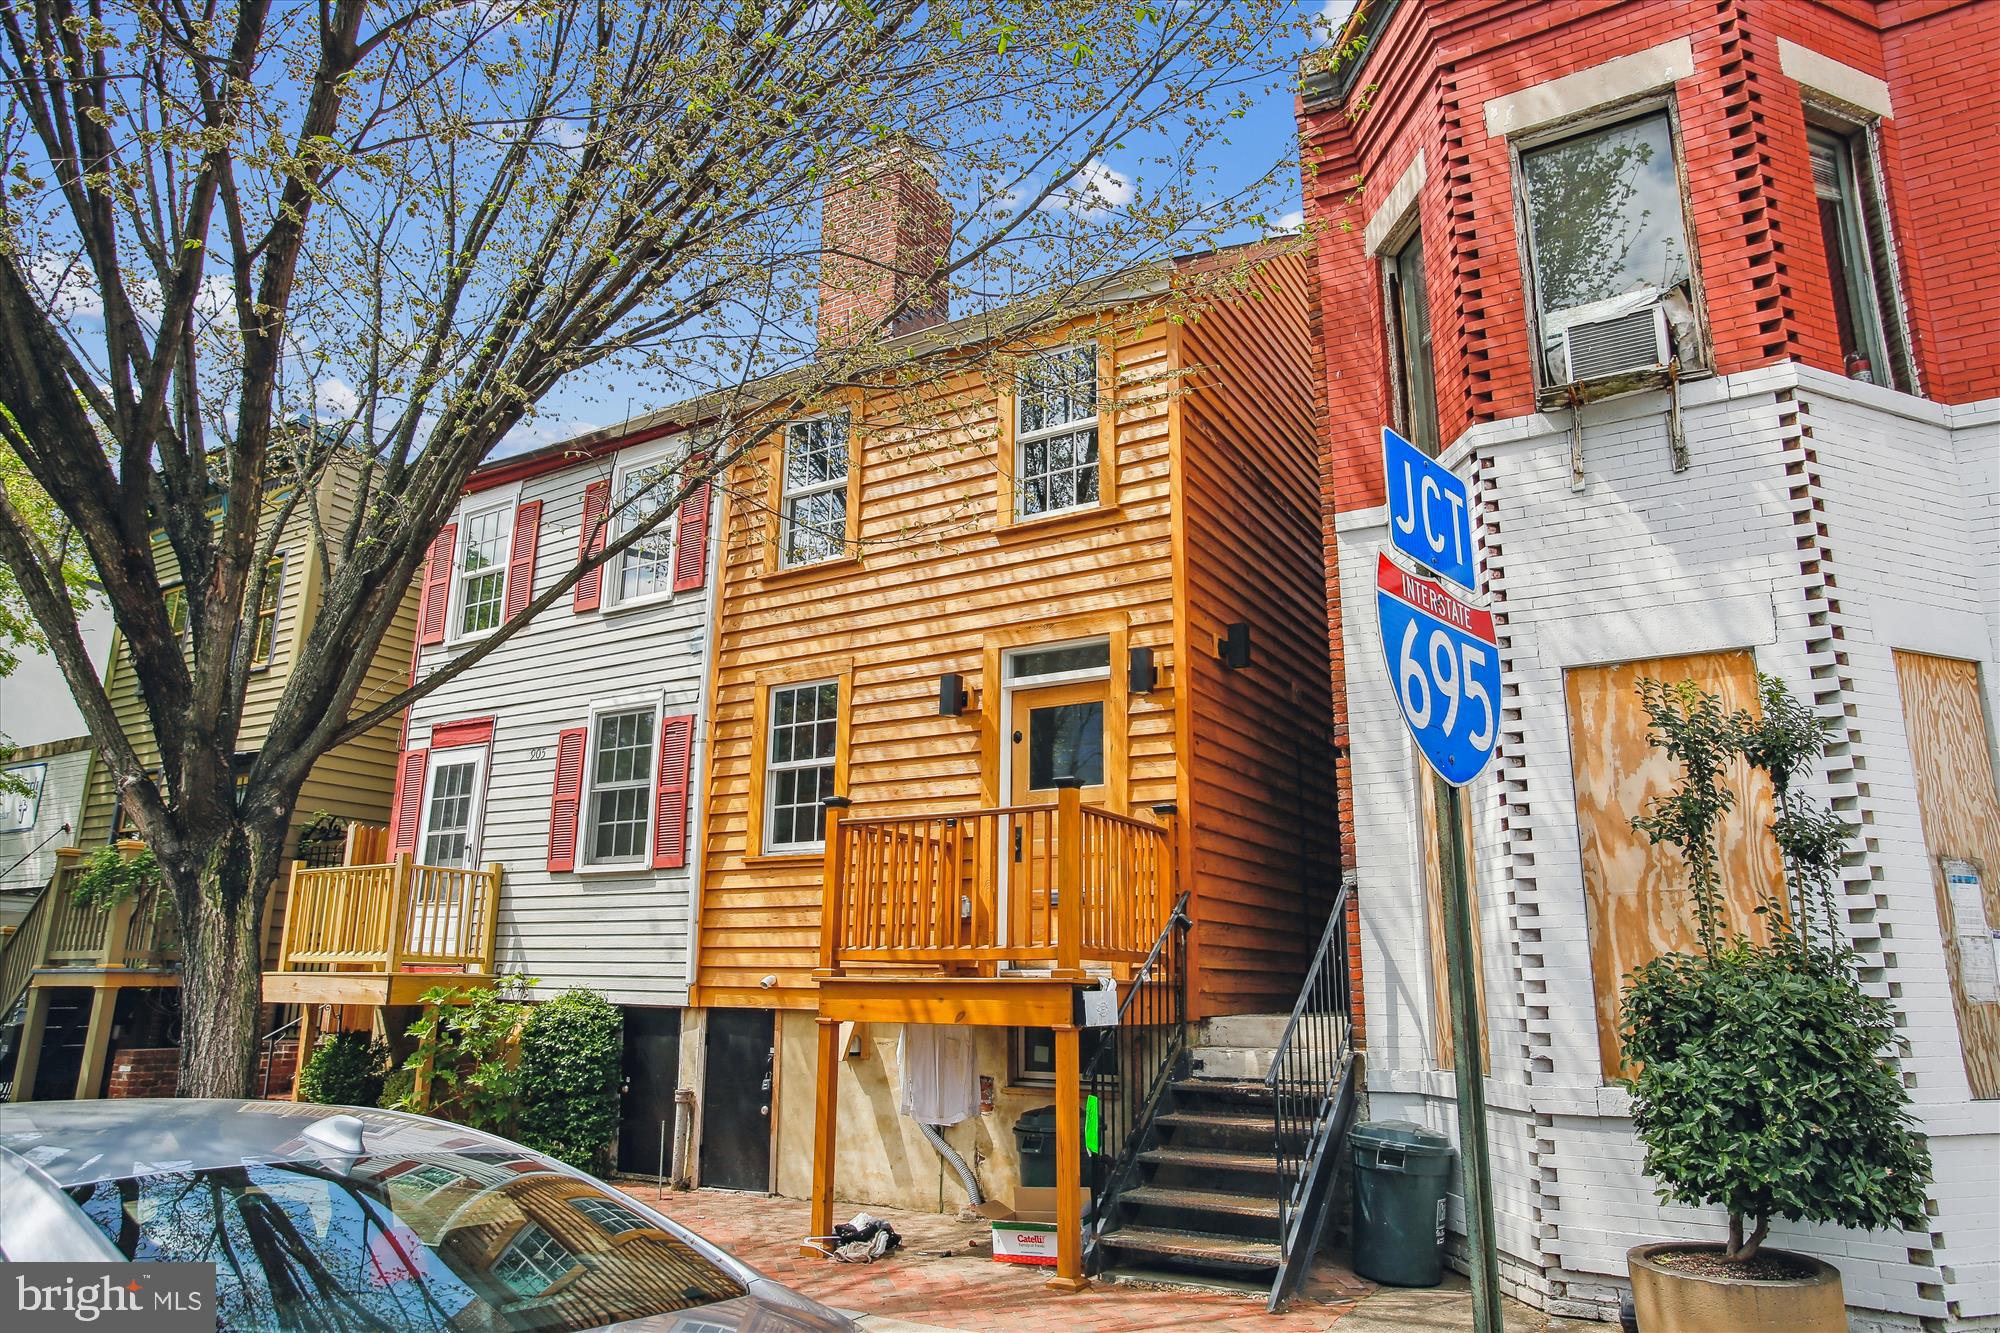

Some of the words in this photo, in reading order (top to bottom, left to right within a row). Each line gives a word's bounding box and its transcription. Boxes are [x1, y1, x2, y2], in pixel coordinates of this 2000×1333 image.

[1395, 461, 1464, 565] JCT
[1401, 573, 1473, 630] INTERSTATE
[1400, 617, 1493, 752] 695
[530, 747, 547, 760] 905
